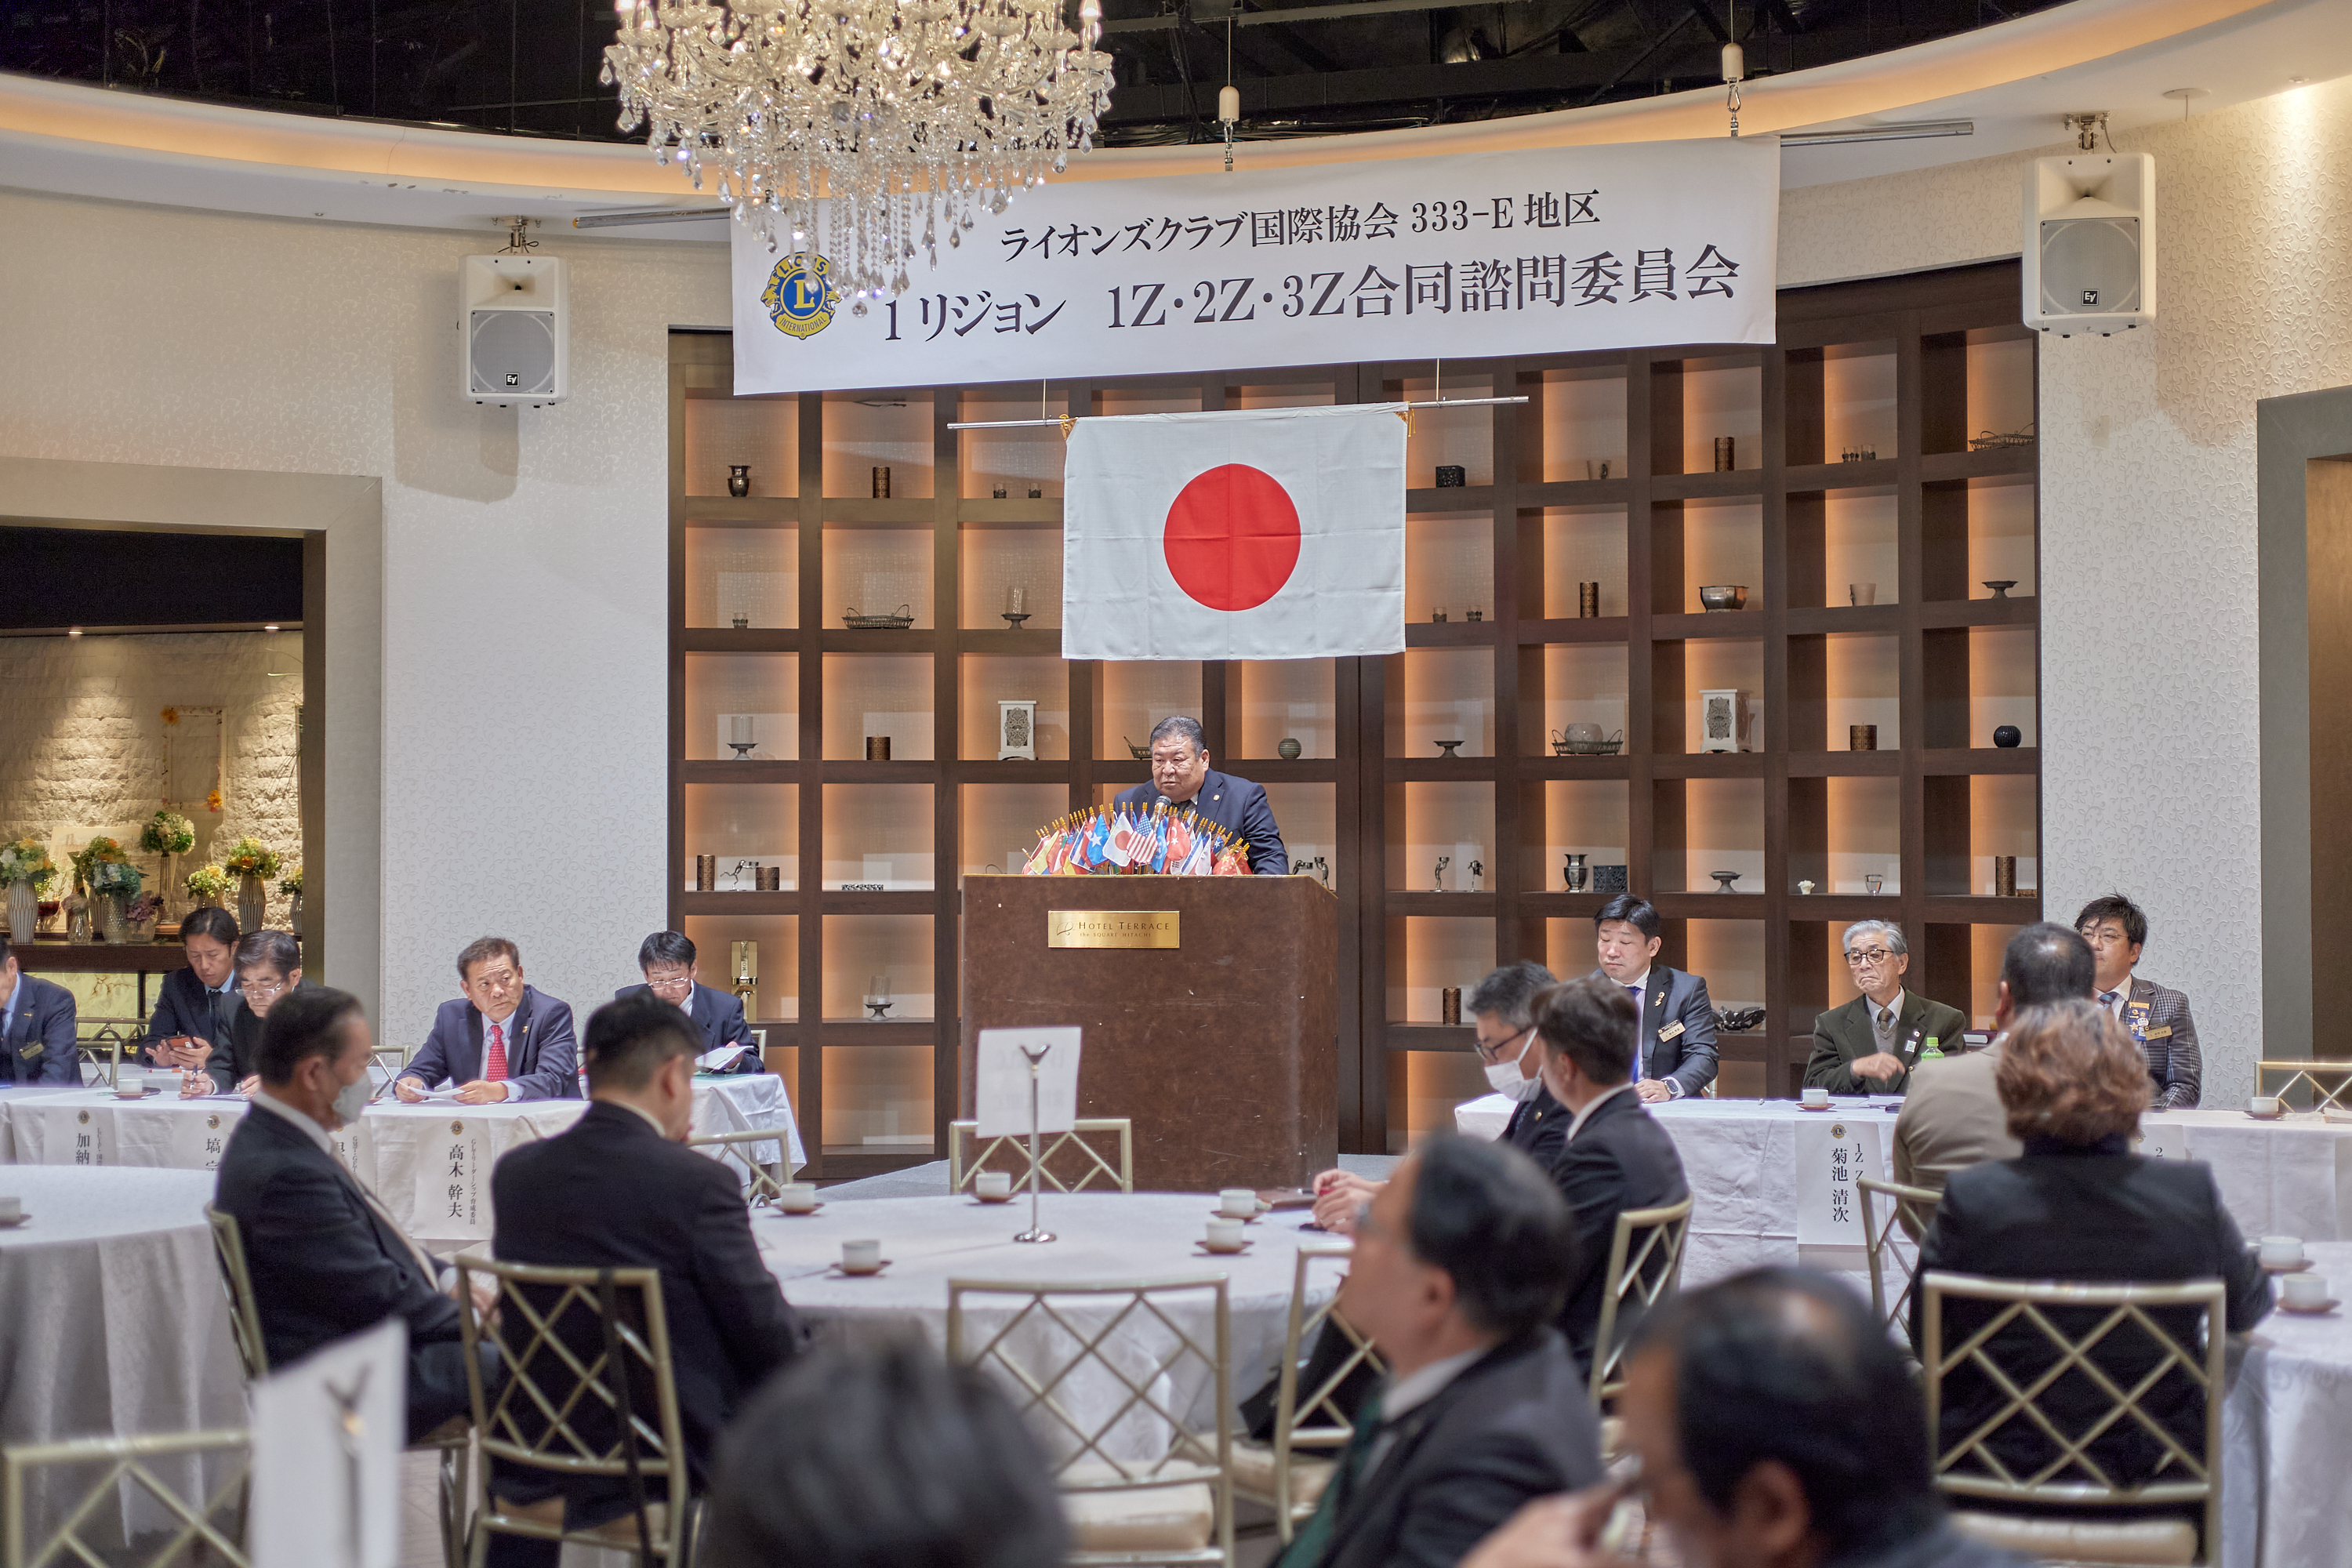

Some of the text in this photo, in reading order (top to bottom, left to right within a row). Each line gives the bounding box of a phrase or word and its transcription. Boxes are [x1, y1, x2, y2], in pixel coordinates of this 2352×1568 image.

[1001, 189, 1601, 262] ライオンズクラブ国際協会 333-E 地区
[779, 316, 827, 332] INTERNATIONAL
[75, 1133, 90, 1165] 加納
[205, 1138, 221, 1154] 塙
[1855, 1143, 1864, 1190] 1Z Z
[447, 1144, 464, 1218] 高木 幹夫
[1831, 1148, 1849, 1223] 菊池 清次
